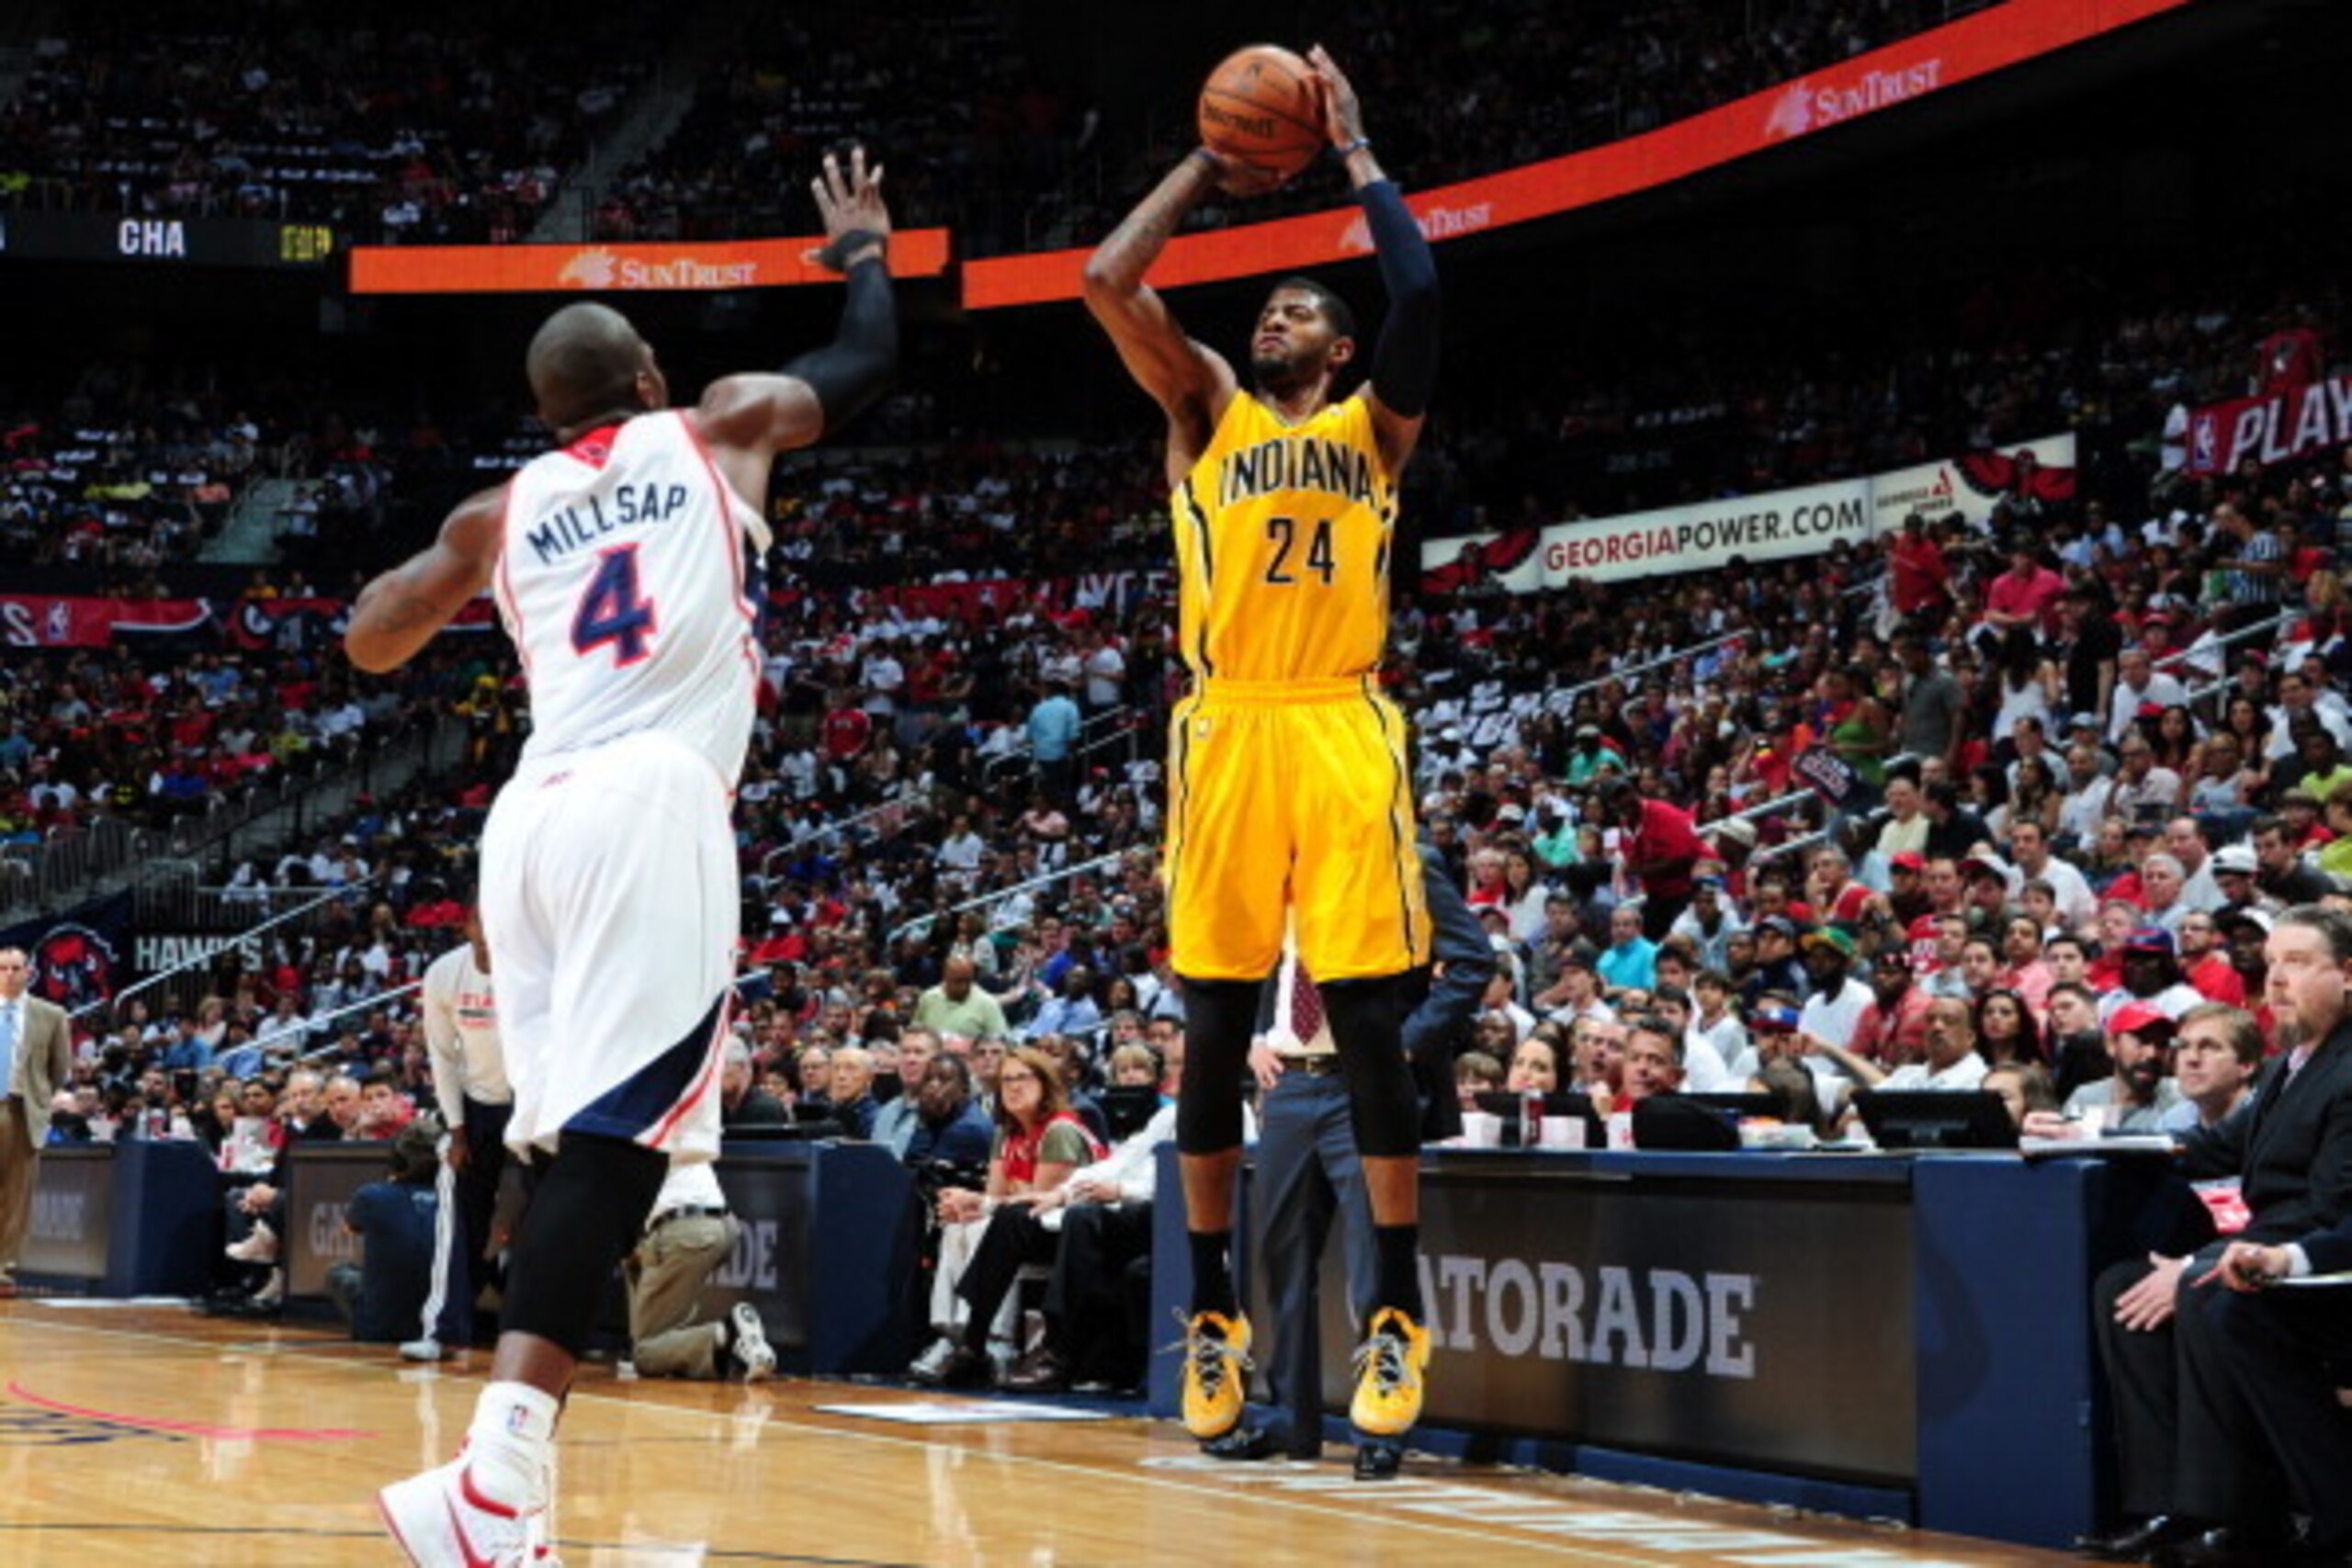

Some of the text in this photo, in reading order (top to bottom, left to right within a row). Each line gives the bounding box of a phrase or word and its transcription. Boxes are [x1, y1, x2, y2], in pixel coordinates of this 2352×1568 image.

[119, 220, 186, 256] CHA
[1218, 437, 1376, 510] INDIANA
[526, 482, 687, 566] MILLSAP
[1265, 517, 1335, 585] 24
[1546, 498, 1864, 571] GEORGIAPOWER.COM
[571, 541, 658, 669] 4
